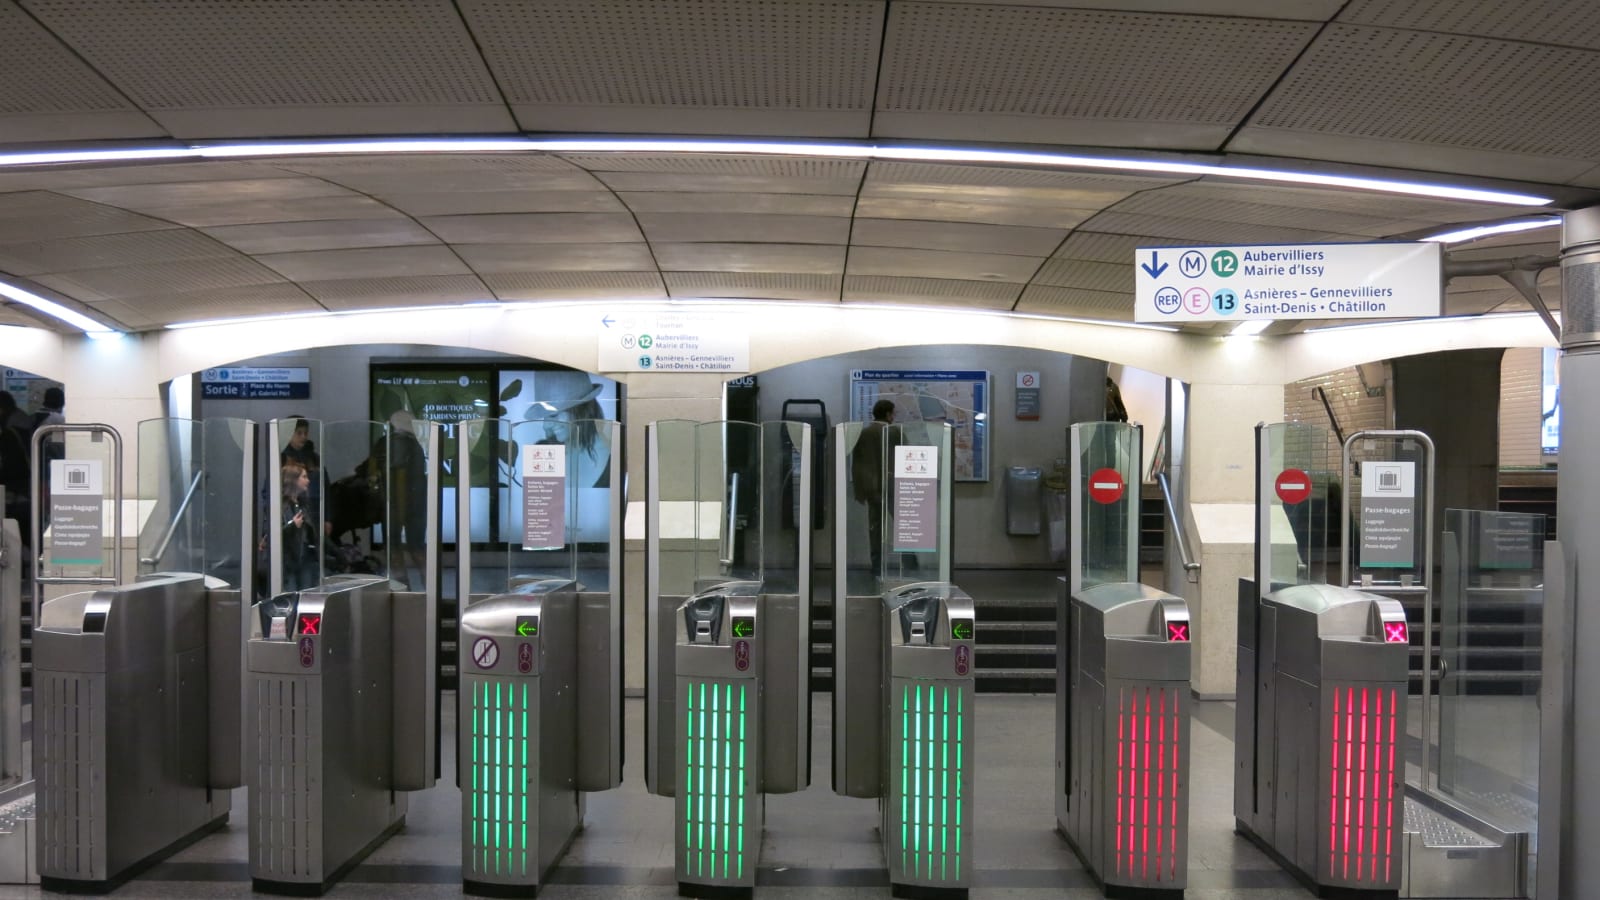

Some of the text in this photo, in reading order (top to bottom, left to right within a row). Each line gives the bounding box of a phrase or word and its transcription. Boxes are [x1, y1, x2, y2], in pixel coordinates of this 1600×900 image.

[1243, 249, 1325, 262] Aubervilliers
[1214, 256, 1235, 272] 12
[1244, 263, 1325, 278] Mairie d'Issy
[1244, 285, 1393, 300] Asnières Gennevilliers
[1158, 295, 1178, 306] RER
[1214, 294, 1235, 310] 13
[1244, 300, 1386, 314] Saint-Denis Châtillon
[640, 337, 650, 346] 12
[656, 334, 699, 342] Aubervilliers
[640, 357, 650, 366] 13
[205, 384, 238, 395] Sortie
[423, 404, 435, 412] 40
[54, 504, 99, 512] Passe-bagages
[1365, 507, 1411, 515] Passe-bagages
